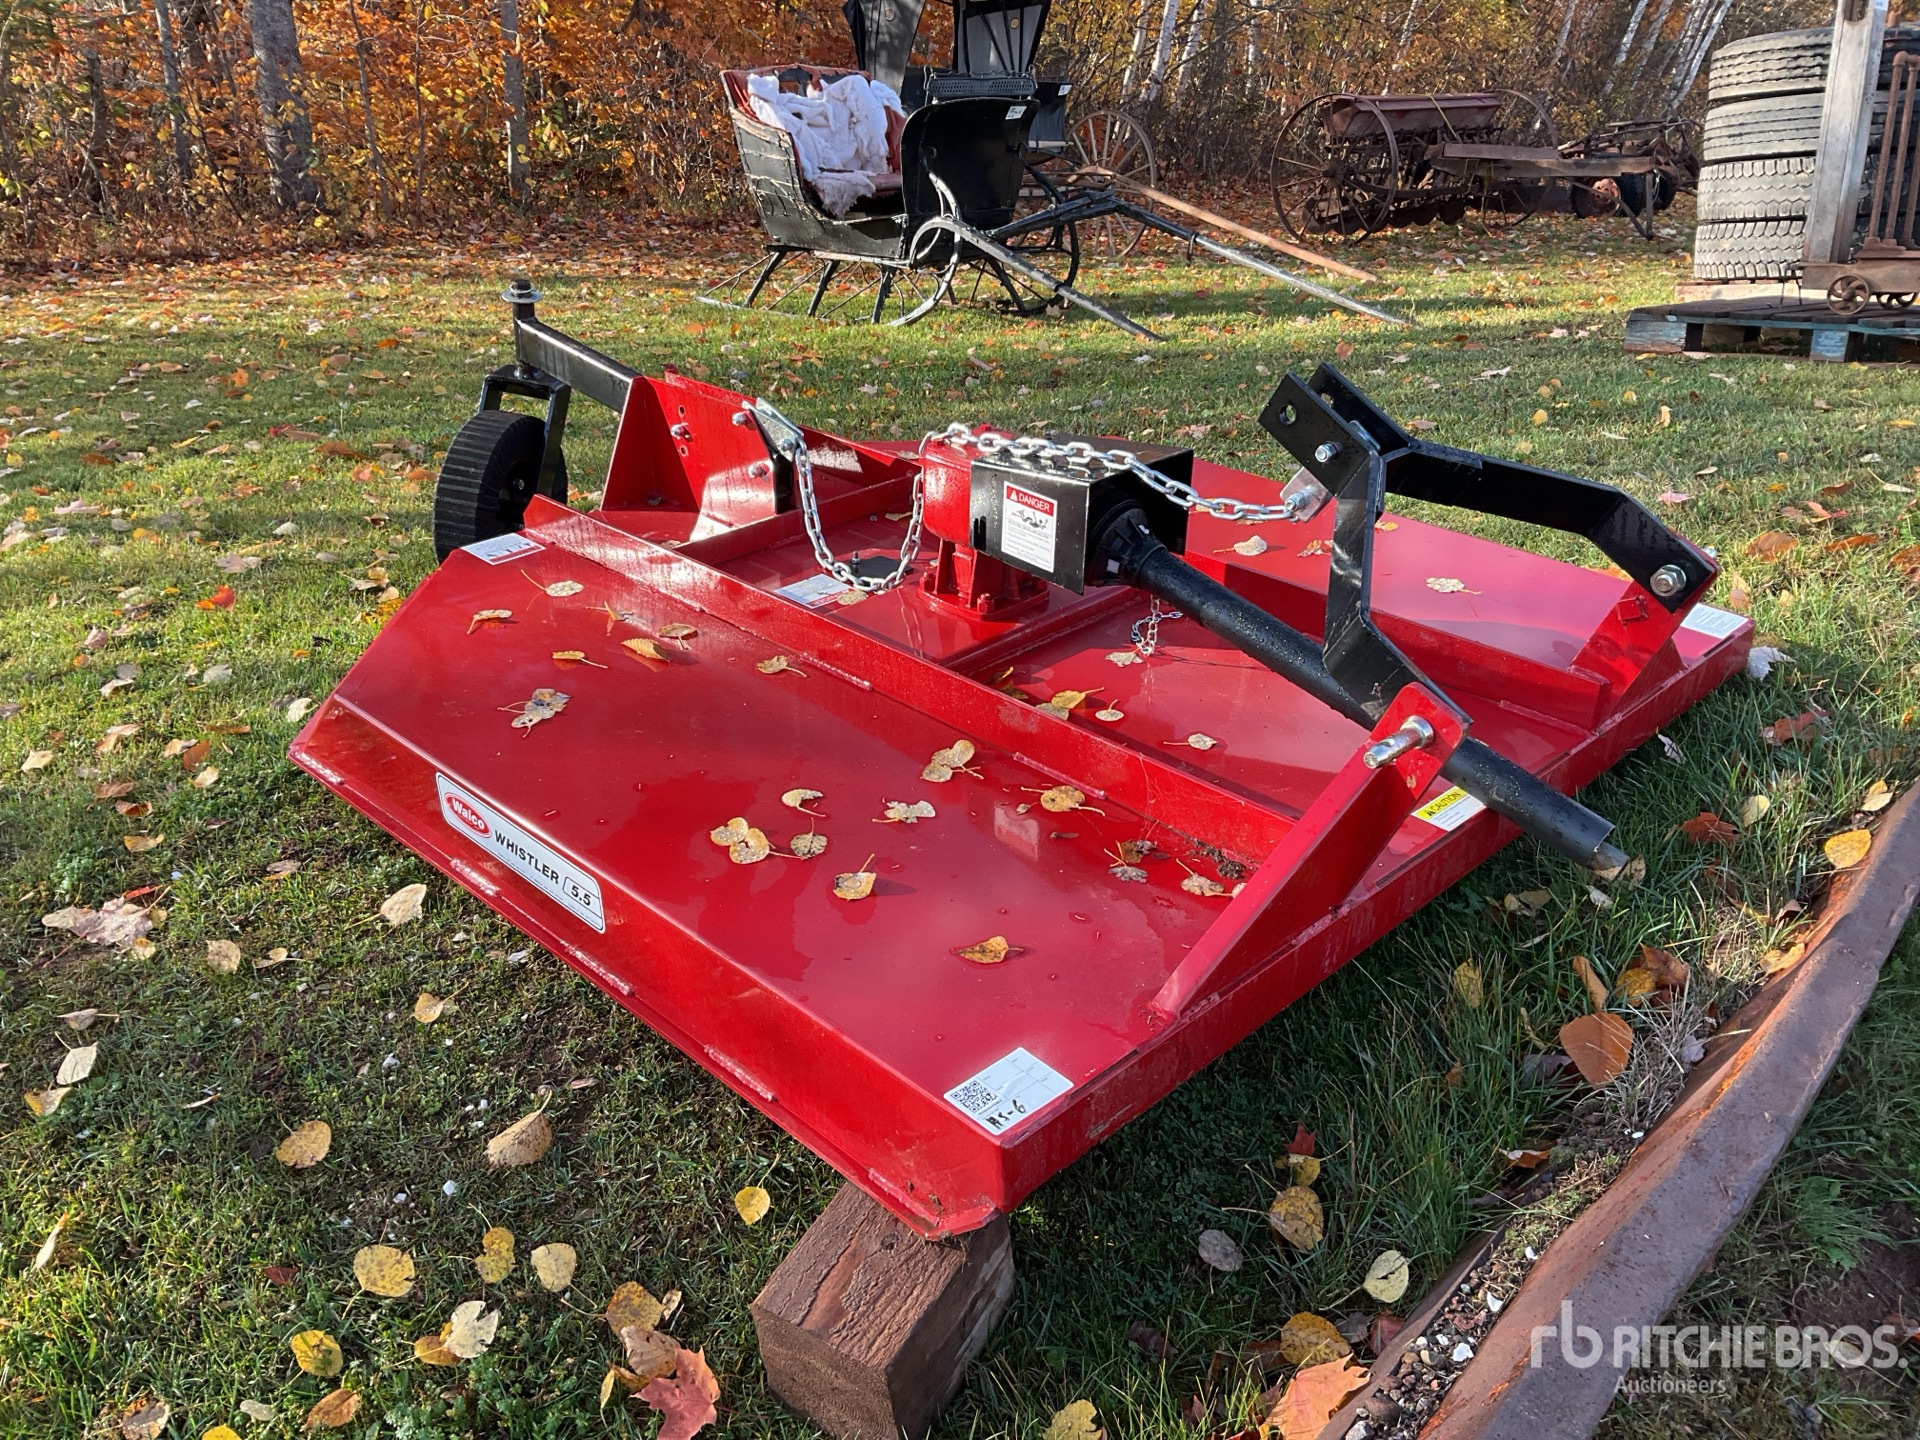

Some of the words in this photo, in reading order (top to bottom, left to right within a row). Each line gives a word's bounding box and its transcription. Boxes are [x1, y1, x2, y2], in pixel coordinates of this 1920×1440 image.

[1018, 493, 1050, 513] DANGER
[451, 798, 485, 830] Walco
[1430, 791, 1461, 811] CAUTION
[495, 829, 559, 884] WHISTLER
[571, 885, 591, 906] 5.5
